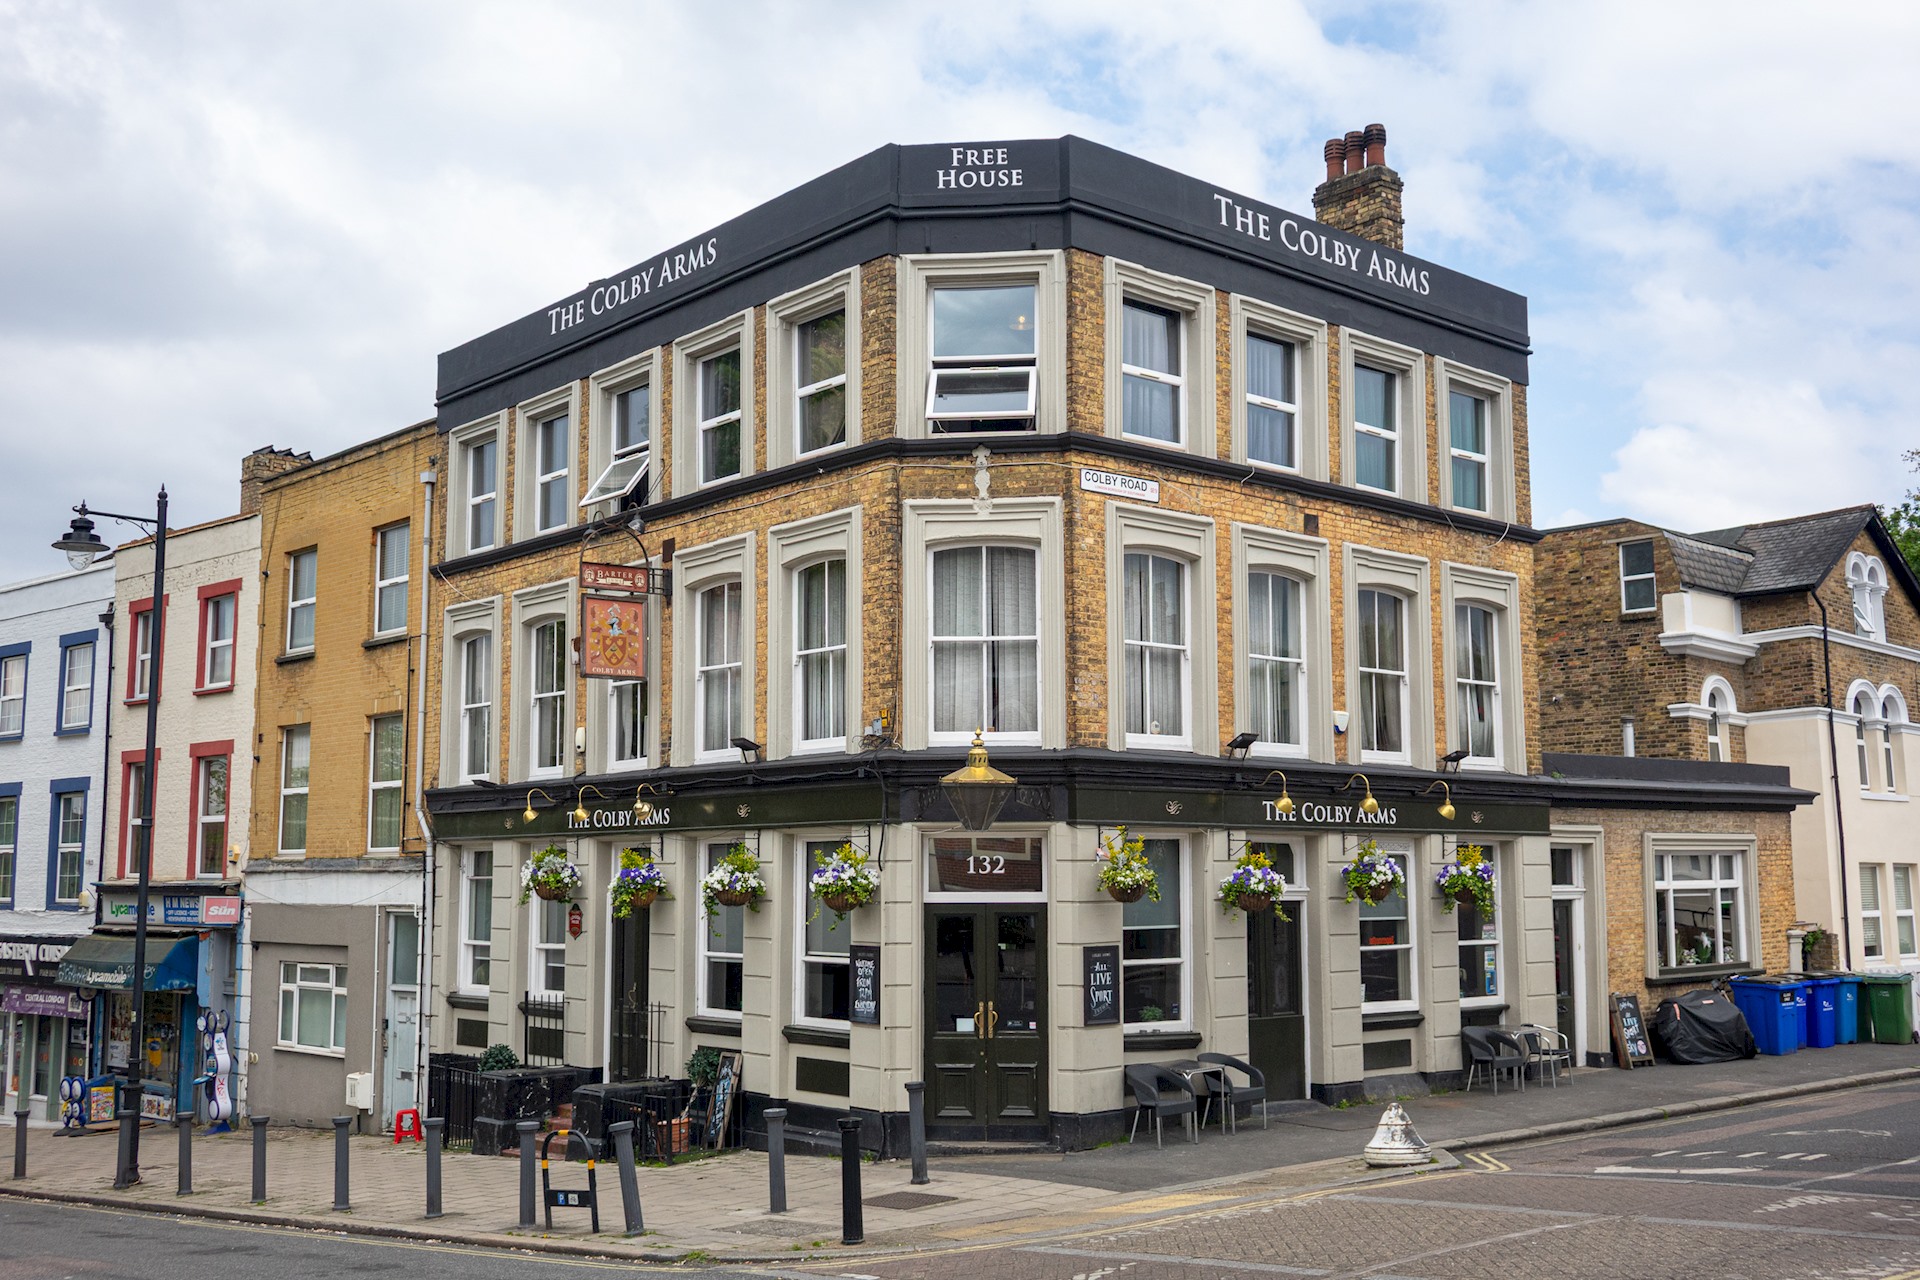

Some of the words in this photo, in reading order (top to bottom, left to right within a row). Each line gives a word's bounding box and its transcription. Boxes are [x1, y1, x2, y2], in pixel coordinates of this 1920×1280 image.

[951, 147, 1008, 167] FREE
[937, 169, 1023, 189] HOUSE
[1214, 193, 1271, 241] THE
[1279, 219, 1361, 272] COLBY
[1366, 250, 1430, 296] ARMS
[548, 300, 585, 335] THE
[590, 266, 654, 316] COLBY
[657, 237, 717, 288] ARMS
[1084, 471, 1118, 486] COLBY
[1120, 477, 1148, 492] ROAD
[597, 570, 634, 579] BARTER
[616, 668, 636, 676] ARMS
[593, 809, 632, 828] COLBY
[1262, 801, 1297, 821] THE
[1301, 802, 1353, 822] COLBY
[1355, 807, 1397, 824] ARMS
[966, 855, 1005, 874] 132
[110, 901, 155, 917] Lycamle
[208, 905, 236, 916] Sun
[87, 969, 127, 983] Lycamobile
[1090, 972, 1111, 985] LIVE
[25, 994, 45, 1003] CENTRAL
[45, 995, 65, 1004] LONDON
